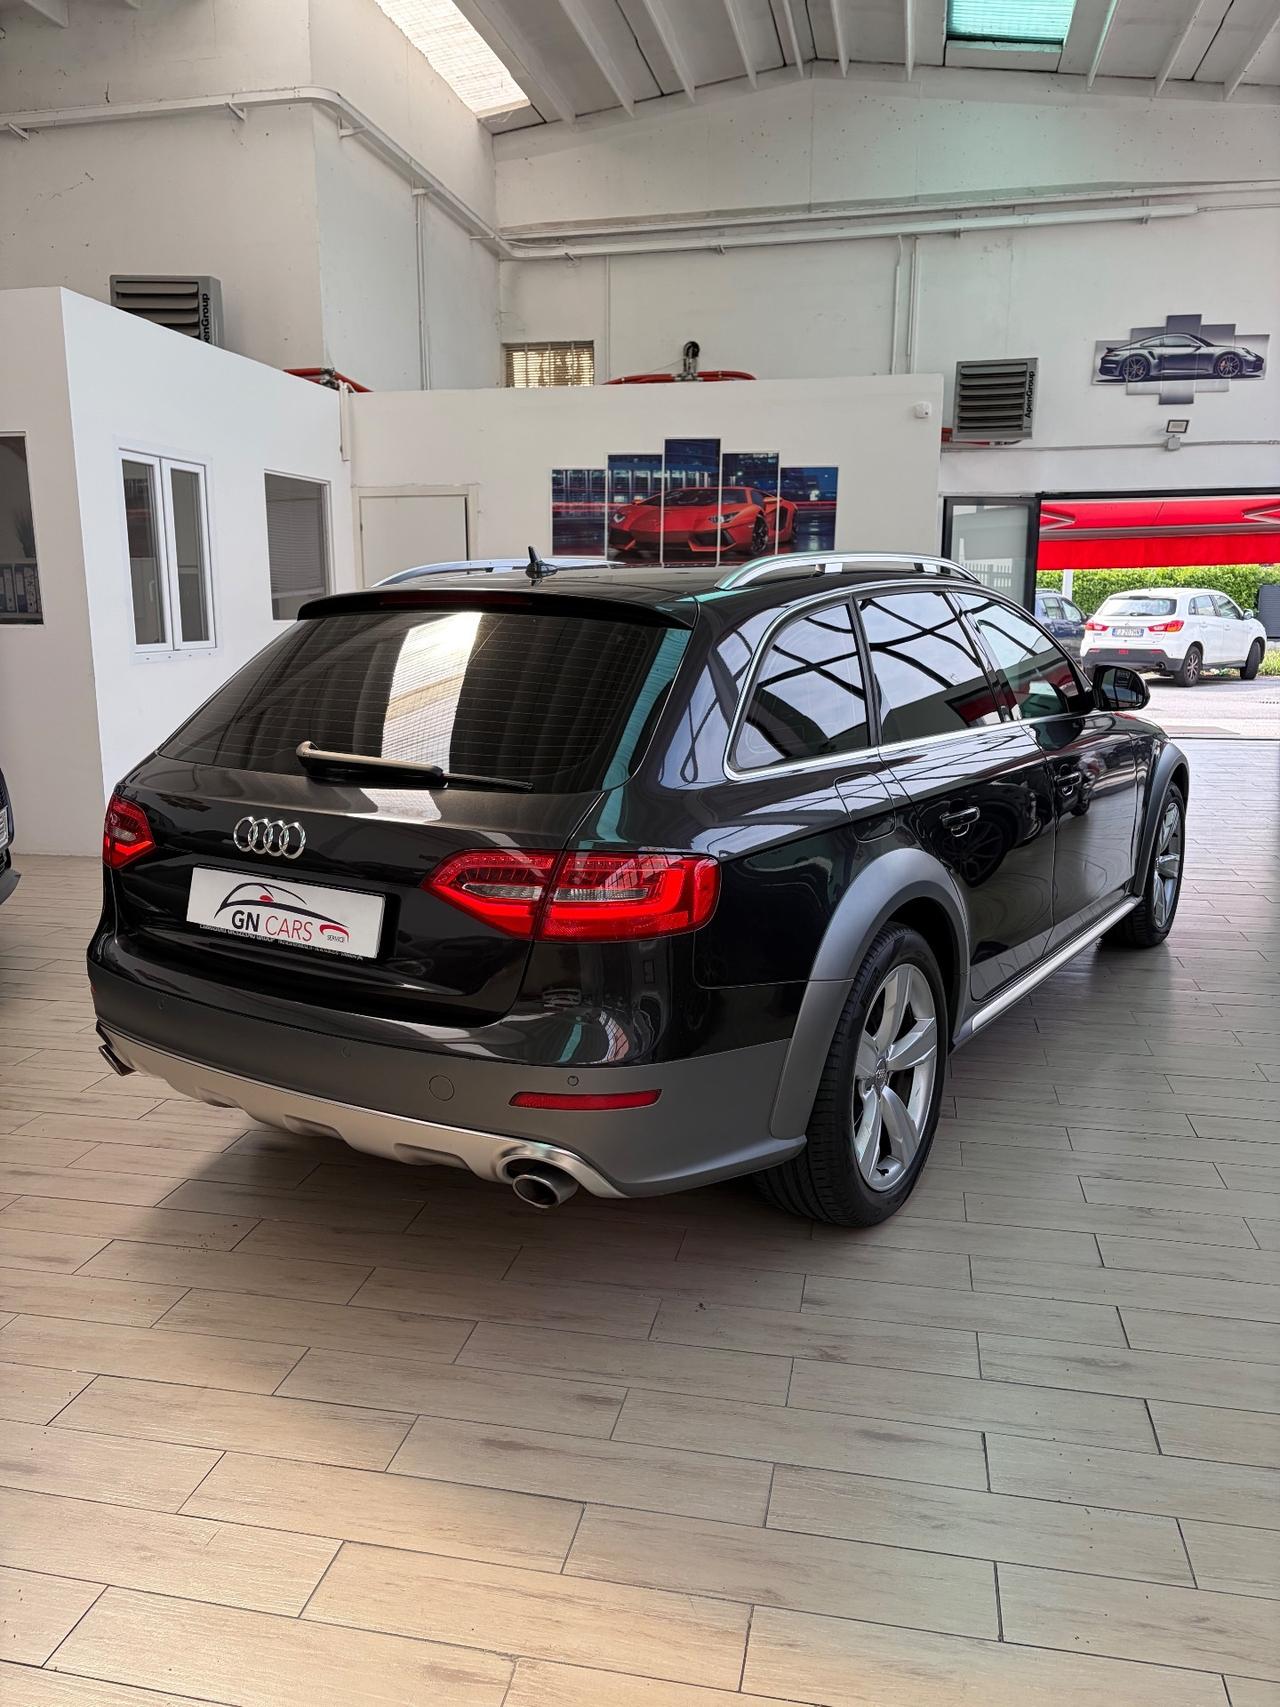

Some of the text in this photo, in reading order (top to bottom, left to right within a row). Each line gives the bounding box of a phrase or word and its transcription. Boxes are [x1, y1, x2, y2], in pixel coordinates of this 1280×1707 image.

[201, 293, 210, 343] enGroup
[1025, 371, 1035, 418] ApenGroup
[231, 910, 260, 932] GN
[265, 915, 313, 942] CARS
[326, 934, 346, 943] SERVICE
